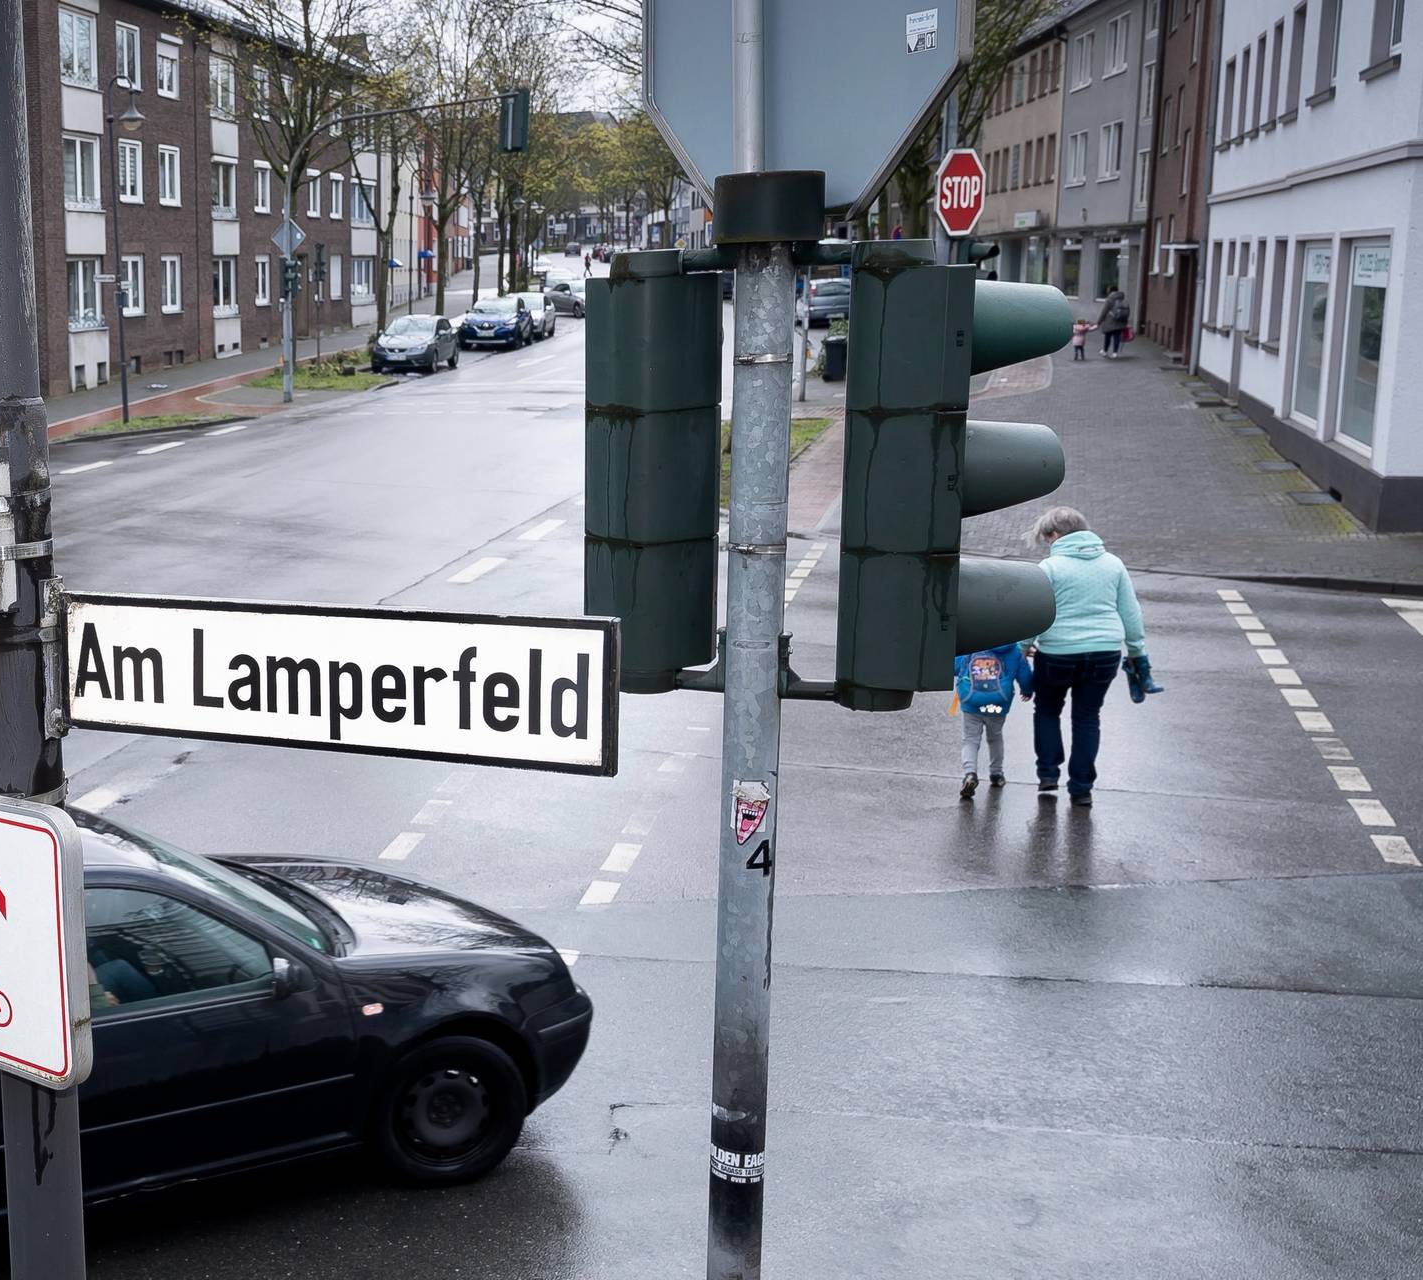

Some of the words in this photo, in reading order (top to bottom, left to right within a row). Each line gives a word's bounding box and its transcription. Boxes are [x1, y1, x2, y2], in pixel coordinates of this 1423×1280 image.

[941, 175, 981, 210] STOP
[77, 622, 164, 704] Am
[193, 628, 589, 741] Lamperfeld
[746, 839, 772, 877] 4
[744, 1151, 765, 1168] EAG
